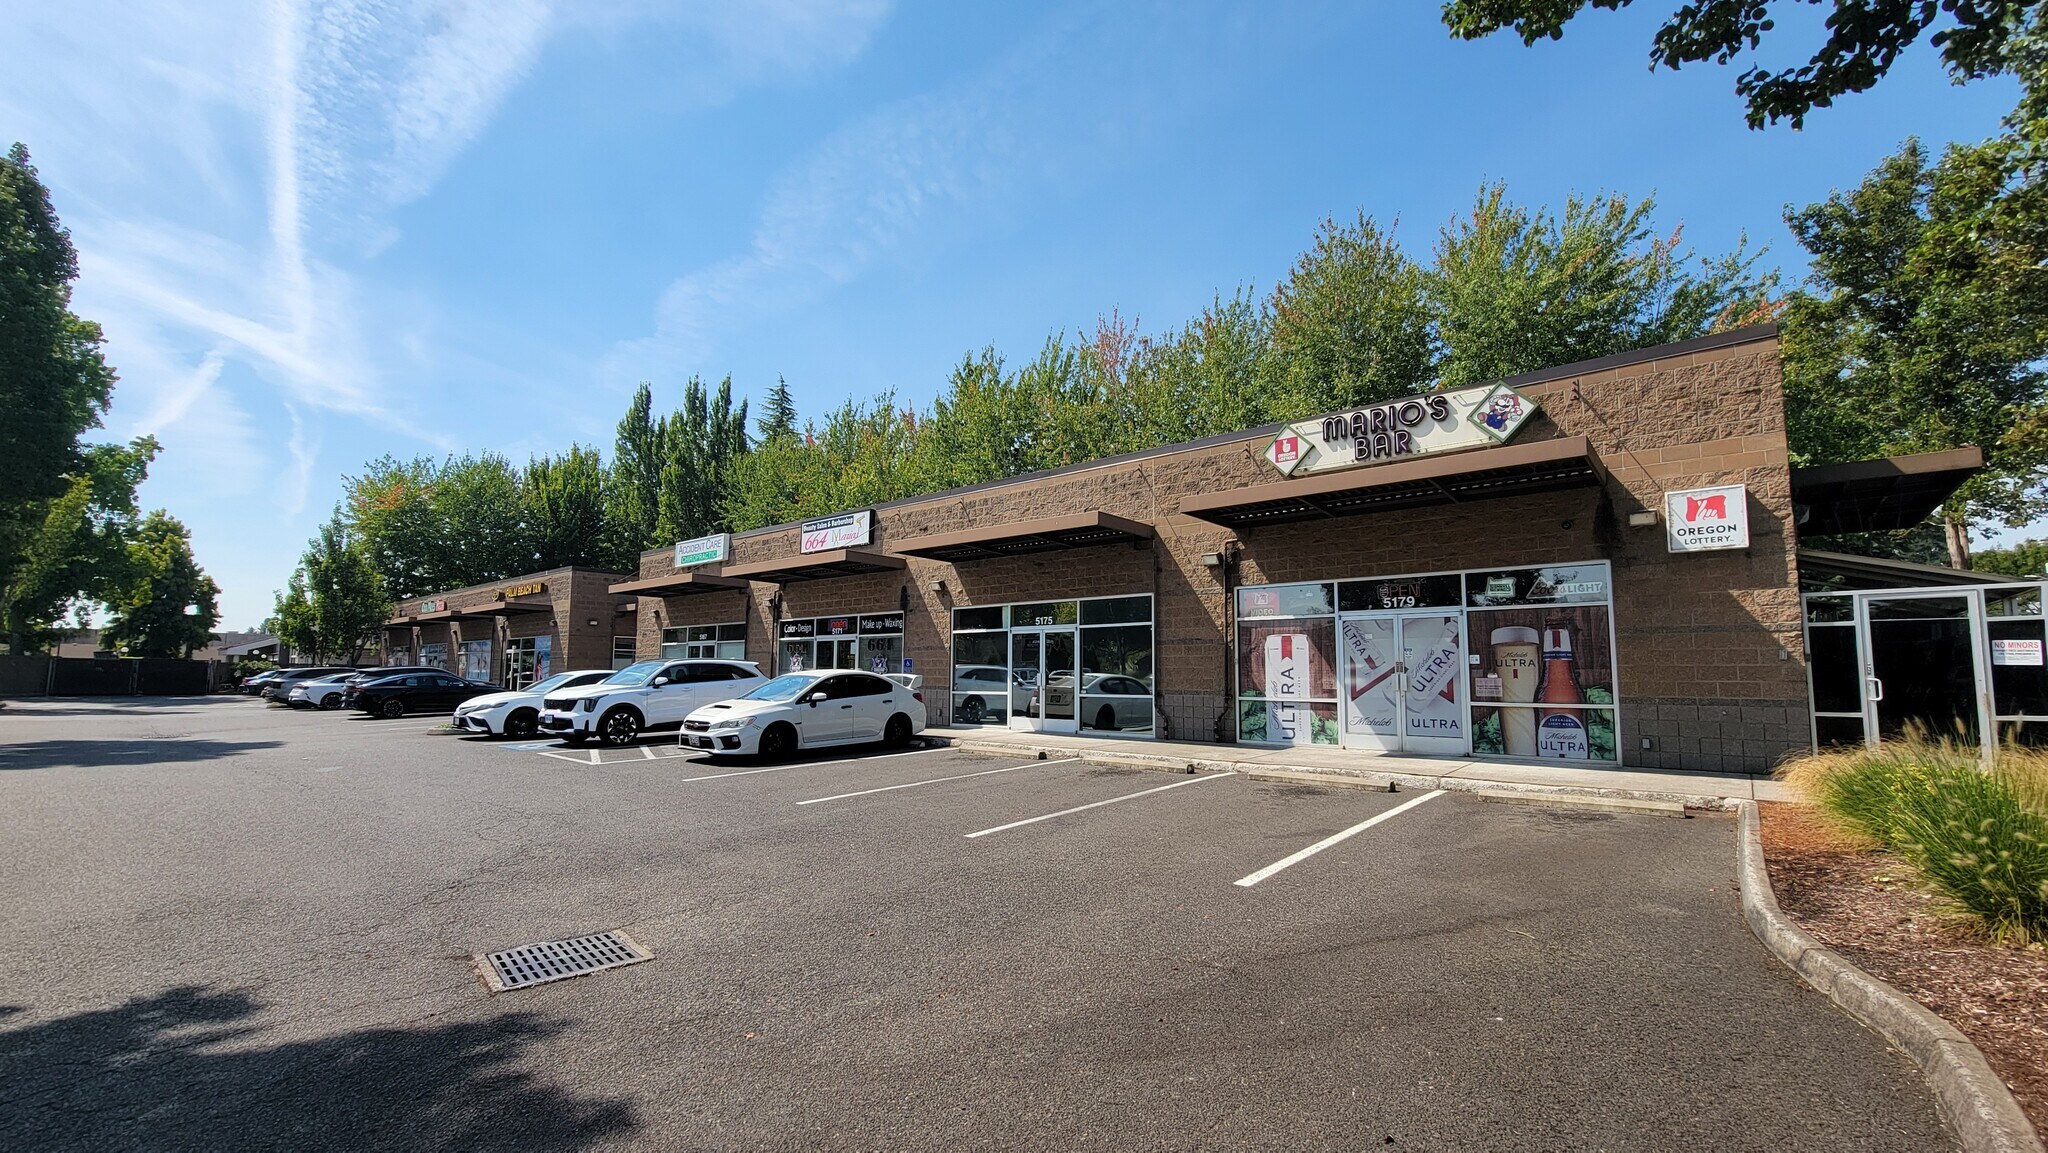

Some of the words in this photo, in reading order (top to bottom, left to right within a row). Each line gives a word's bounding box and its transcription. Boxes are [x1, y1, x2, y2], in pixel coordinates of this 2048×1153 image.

[1322, 395, 1450, 442] MARIO'S
[1355, 429, 1412, 460] BAR
[1677, 524, 1737, 537] OREGON
[679, 542, 705, 554] ACCIDENT
[706, 538, 722, 550] CARE
[804, 531, 829, 550] 664
[1684, 535, 1731, 545] LOTTERY
[682, 550, 718, 563] CHIROPRACTIC
[532, 583, 542, 594] TAN
[1567, 583, 1601, 593] LIGHT
[1383, 596, 1415, 608] 5179
[1250, 608, 1273, 616] VIDEO
[861, 619, 875, 629] Make
[875, 621, 882, 630] up
[884, 618, 903, 629] Waxing
[1035, 616, 1053, 625] 5175
[783, 624, 796, 633] Color
[797, 623, 811, 633] Design
[1994, 641, 2005, 649] NO
[2007, 641, 2039, 649] MINORS
[1495, 659, 1536, 667] ULTRA
[1411, 649, 1456, 692] ULTRA
[1280, 666, 1296, 740] ULTRA
[1349, 715, 1393, 727] Michelob
[1411, 718, 1459, 729] ULTRA
[1540, 740, 1586, 751] ULTRA
